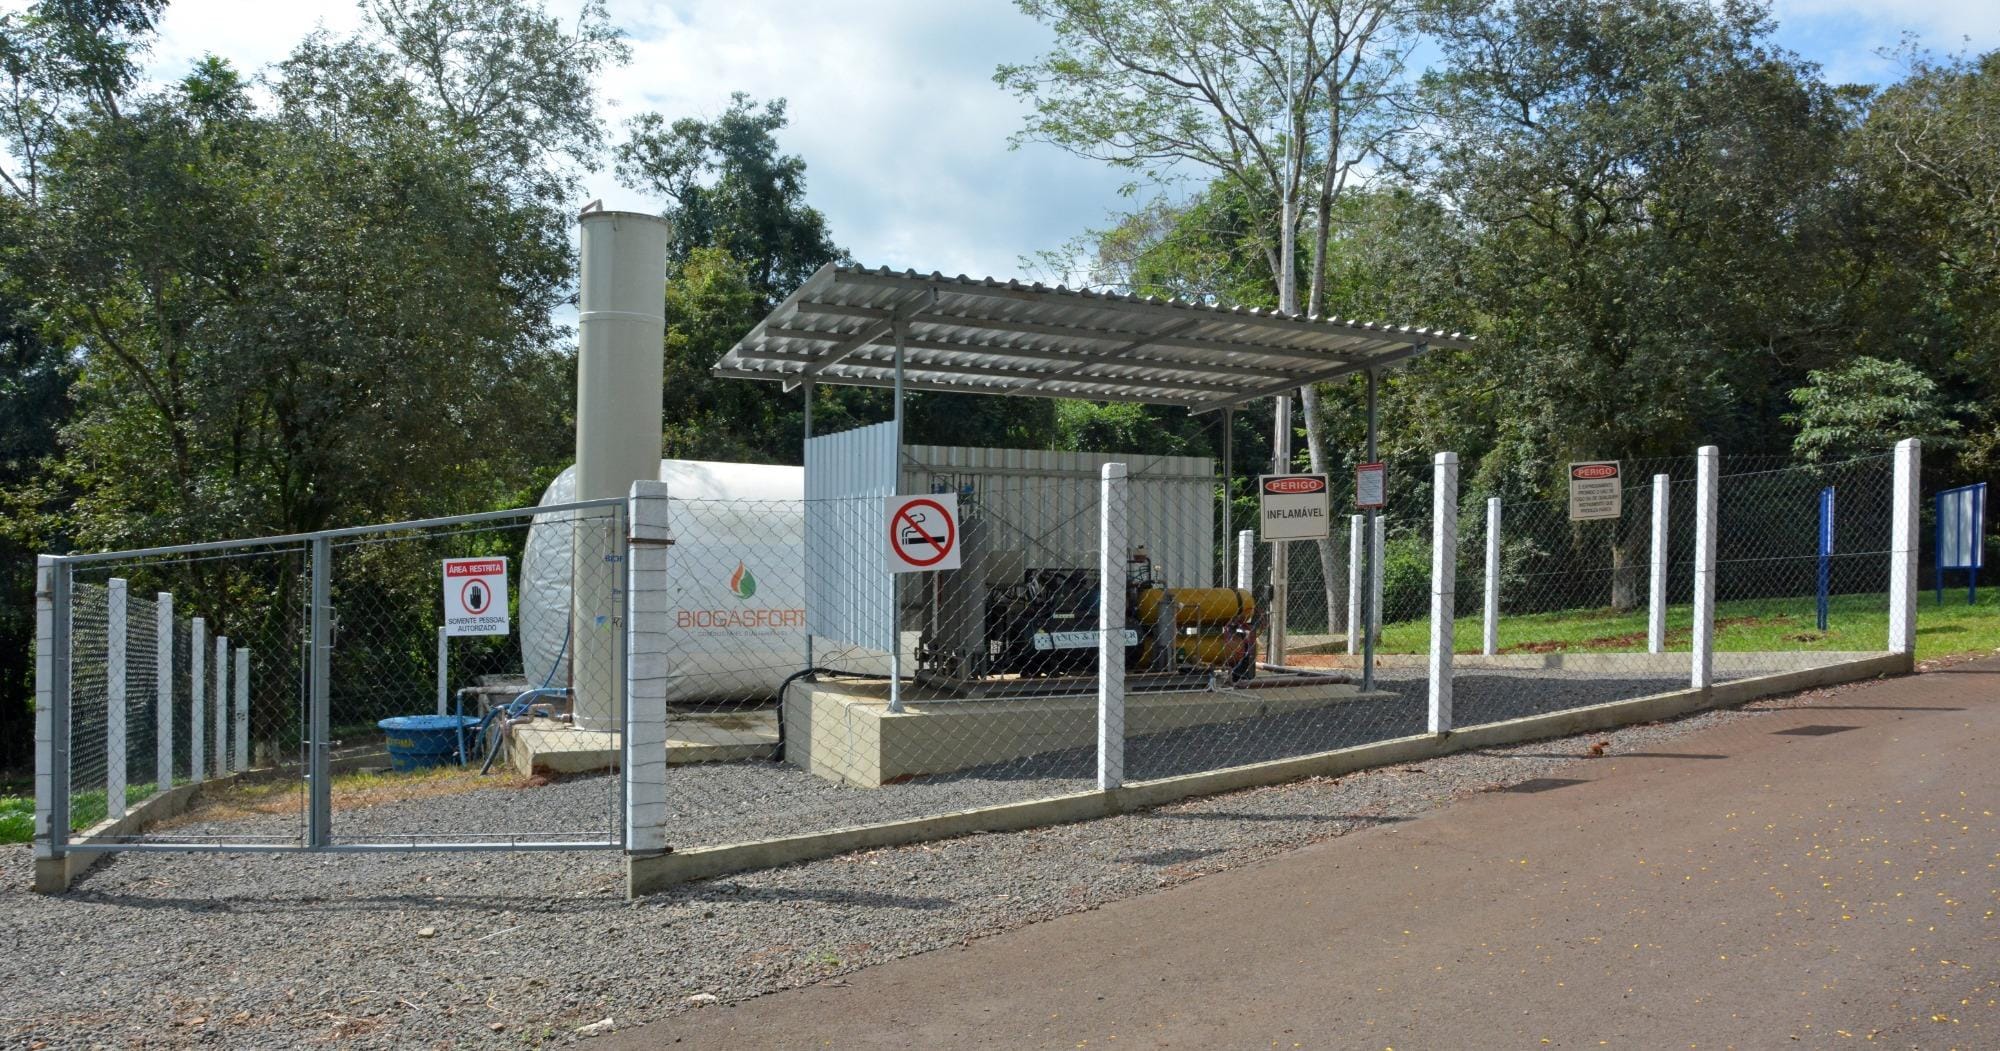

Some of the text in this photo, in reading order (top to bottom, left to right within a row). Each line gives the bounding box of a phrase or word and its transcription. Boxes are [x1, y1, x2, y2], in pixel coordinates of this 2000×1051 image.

[1578, 468, 1612, 476] PERIGO
[1272, 481, 1317, 490] PERIGO
[1267, 506, 1325, 519] INFLAMÁVEL
[449, 563, 501, 573] ÁREA RESTRITA
[448, 616, 506, 625] SOMENTE PESSOAL
[458, 624, 497, 632] AUTORIZADO
